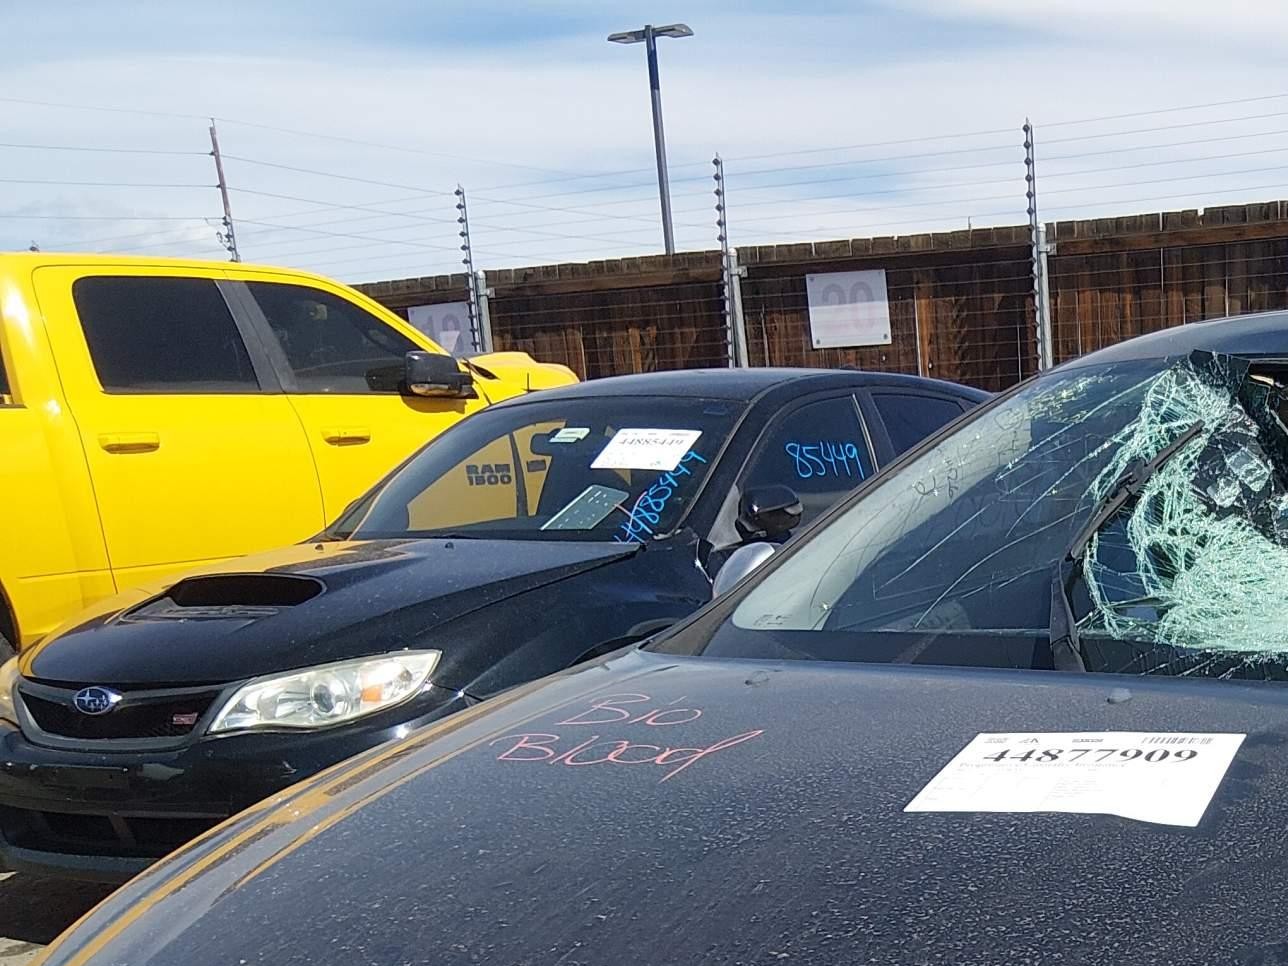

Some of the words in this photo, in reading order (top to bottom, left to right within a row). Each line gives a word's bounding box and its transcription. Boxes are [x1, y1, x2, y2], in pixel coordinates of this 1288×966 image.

[466, 464, 511, 474] RAM
[785, 441, 865, 480] 85449
[554, 693, 703, 726] Bio
[489, 728, 766, 784] Blood
[983, 748, 1200, 763] 44877909
